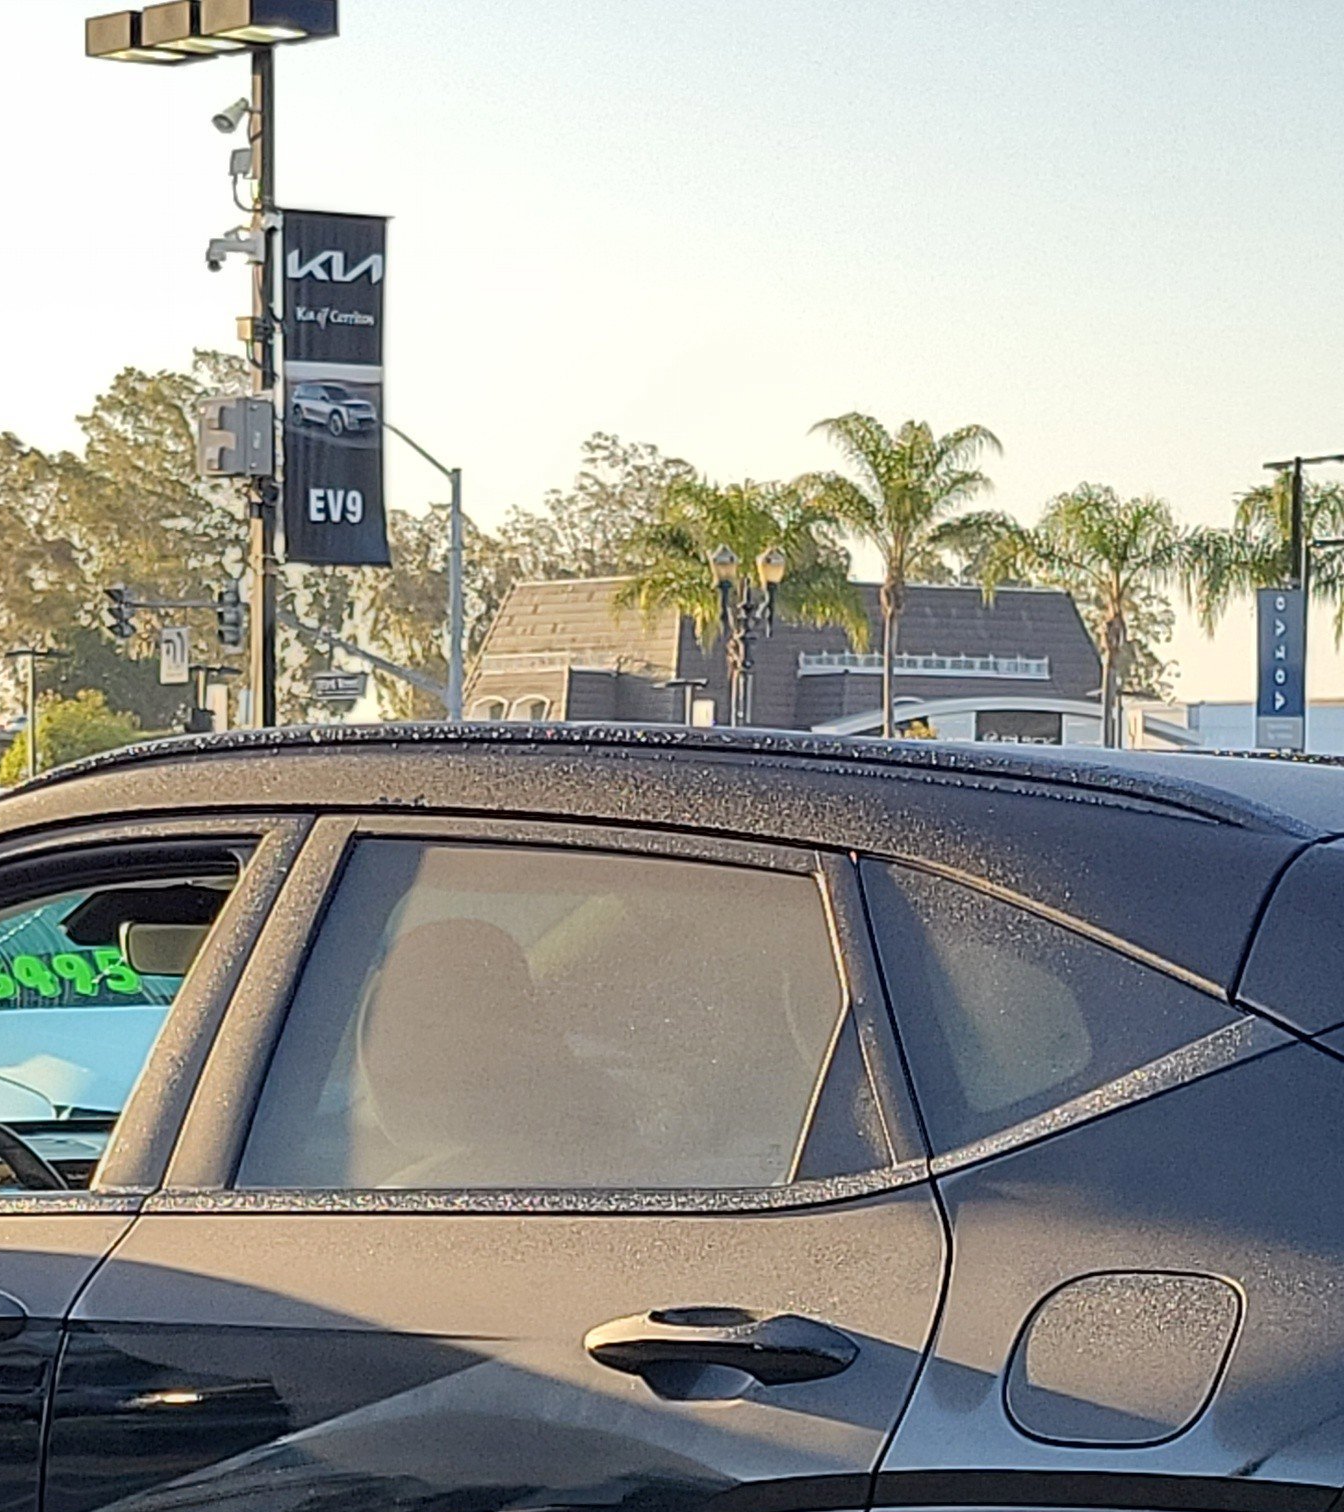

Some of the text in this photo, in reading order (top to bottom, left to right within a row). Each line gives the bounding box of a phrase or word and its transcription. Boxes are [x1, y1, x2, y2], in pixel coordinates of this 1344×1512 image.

[286, 248, 383, 284] KIA
[309, 488, 364, 524] EV9
[1274, 595, 1287, 711] VOLVO
